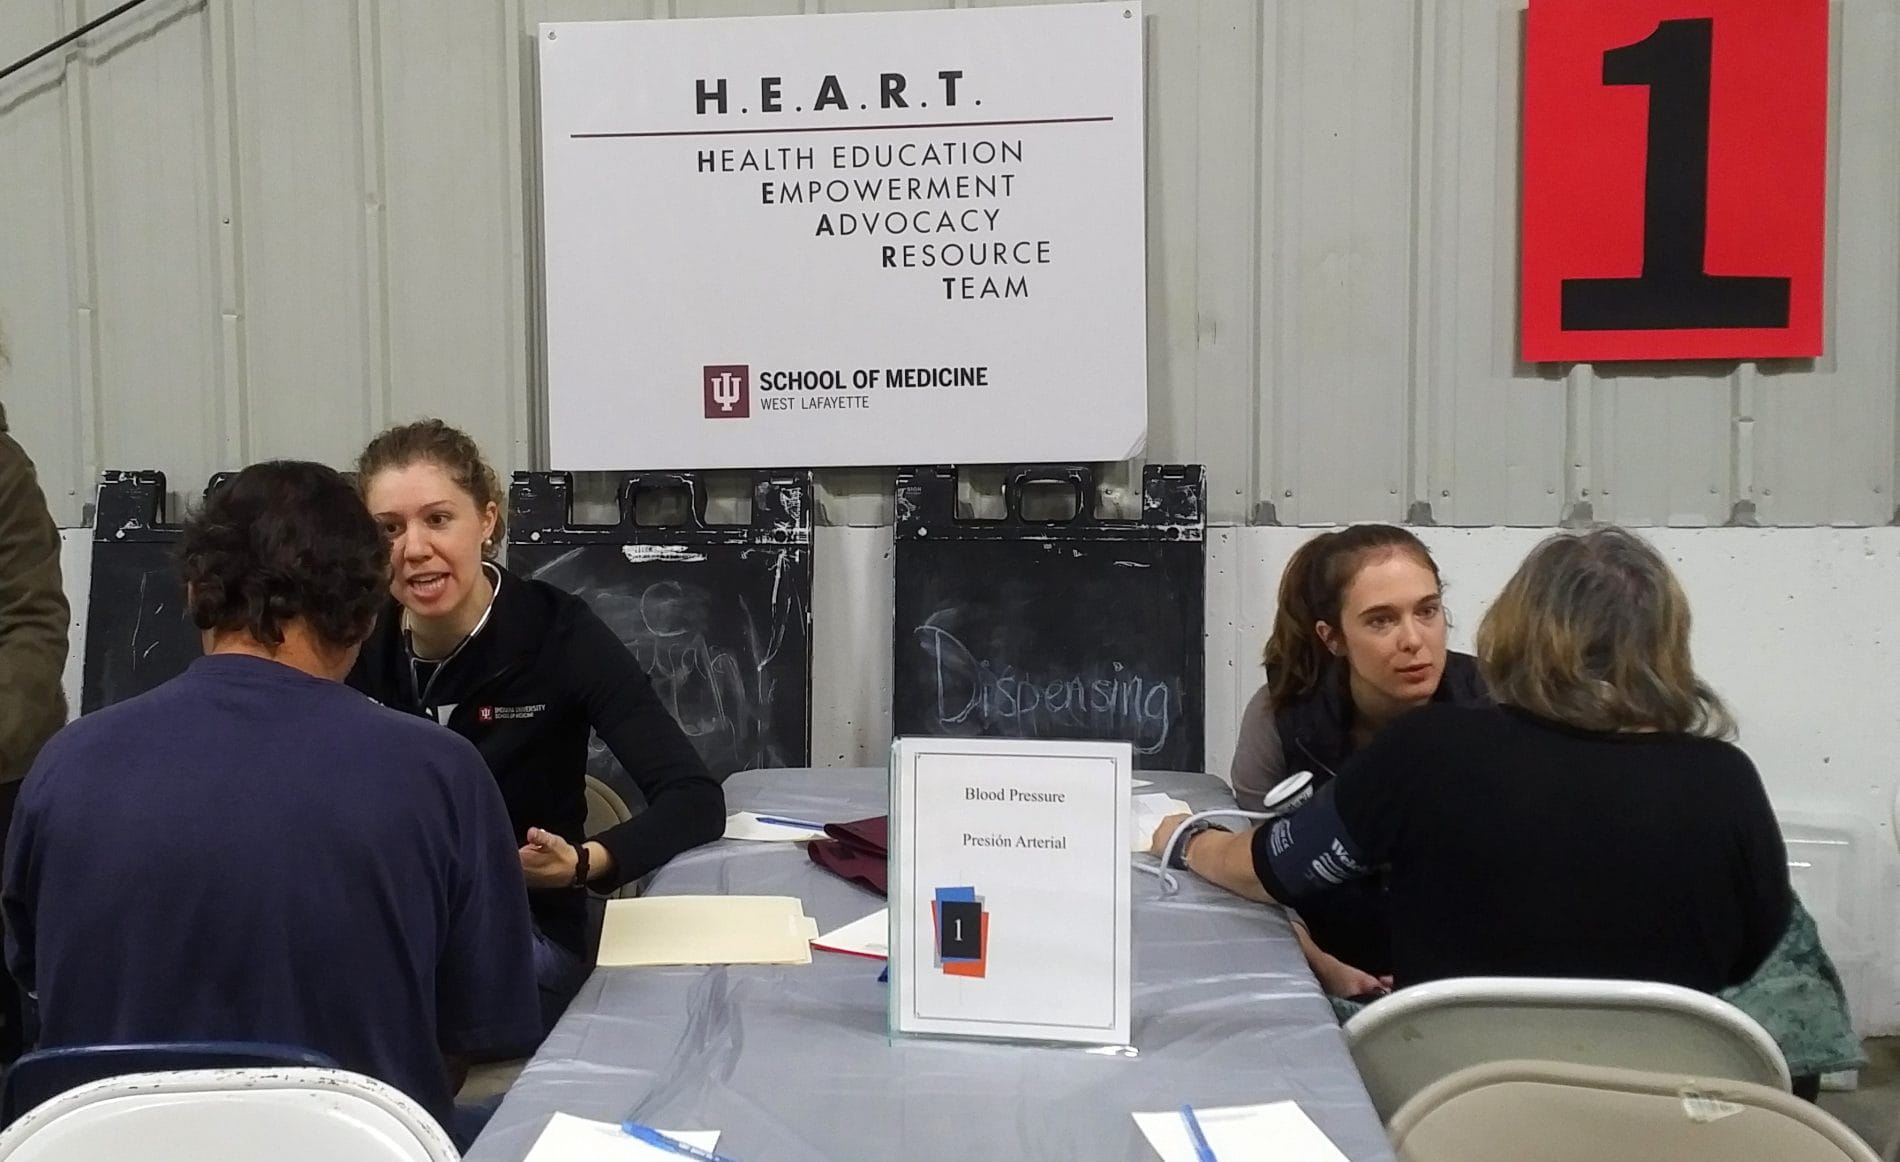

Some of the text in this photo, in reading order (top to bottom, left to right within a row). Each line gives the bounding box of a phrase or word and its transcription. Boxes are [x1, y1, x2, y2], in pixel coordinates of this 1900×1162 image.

[696, 70, 981, 115] H.E.A.R.T.
[698, 140, 1022, 173] HEALTH EDUCATION
[1561, 17, 1791, 331] 1
[762, 174, 1015, 205] EMPOWERMENT
[815, 208, 1000, 237] ADVOCACY
[882, 241, 1051, 268] RESOURCE
[943, 276, 1029, 300] TEAM
[760, 366, 988, 391] SCHOOL OF MEDICINE
[760, 395, 870, 411] WEST LAFAYETTE
[914, 626, 1169, 754] Dispensing
[965, 787, 1065, 803] Blood Pressure
[963, 833, 1066, 849] Presión Arterial
[953, 918, 963, 941] 1
